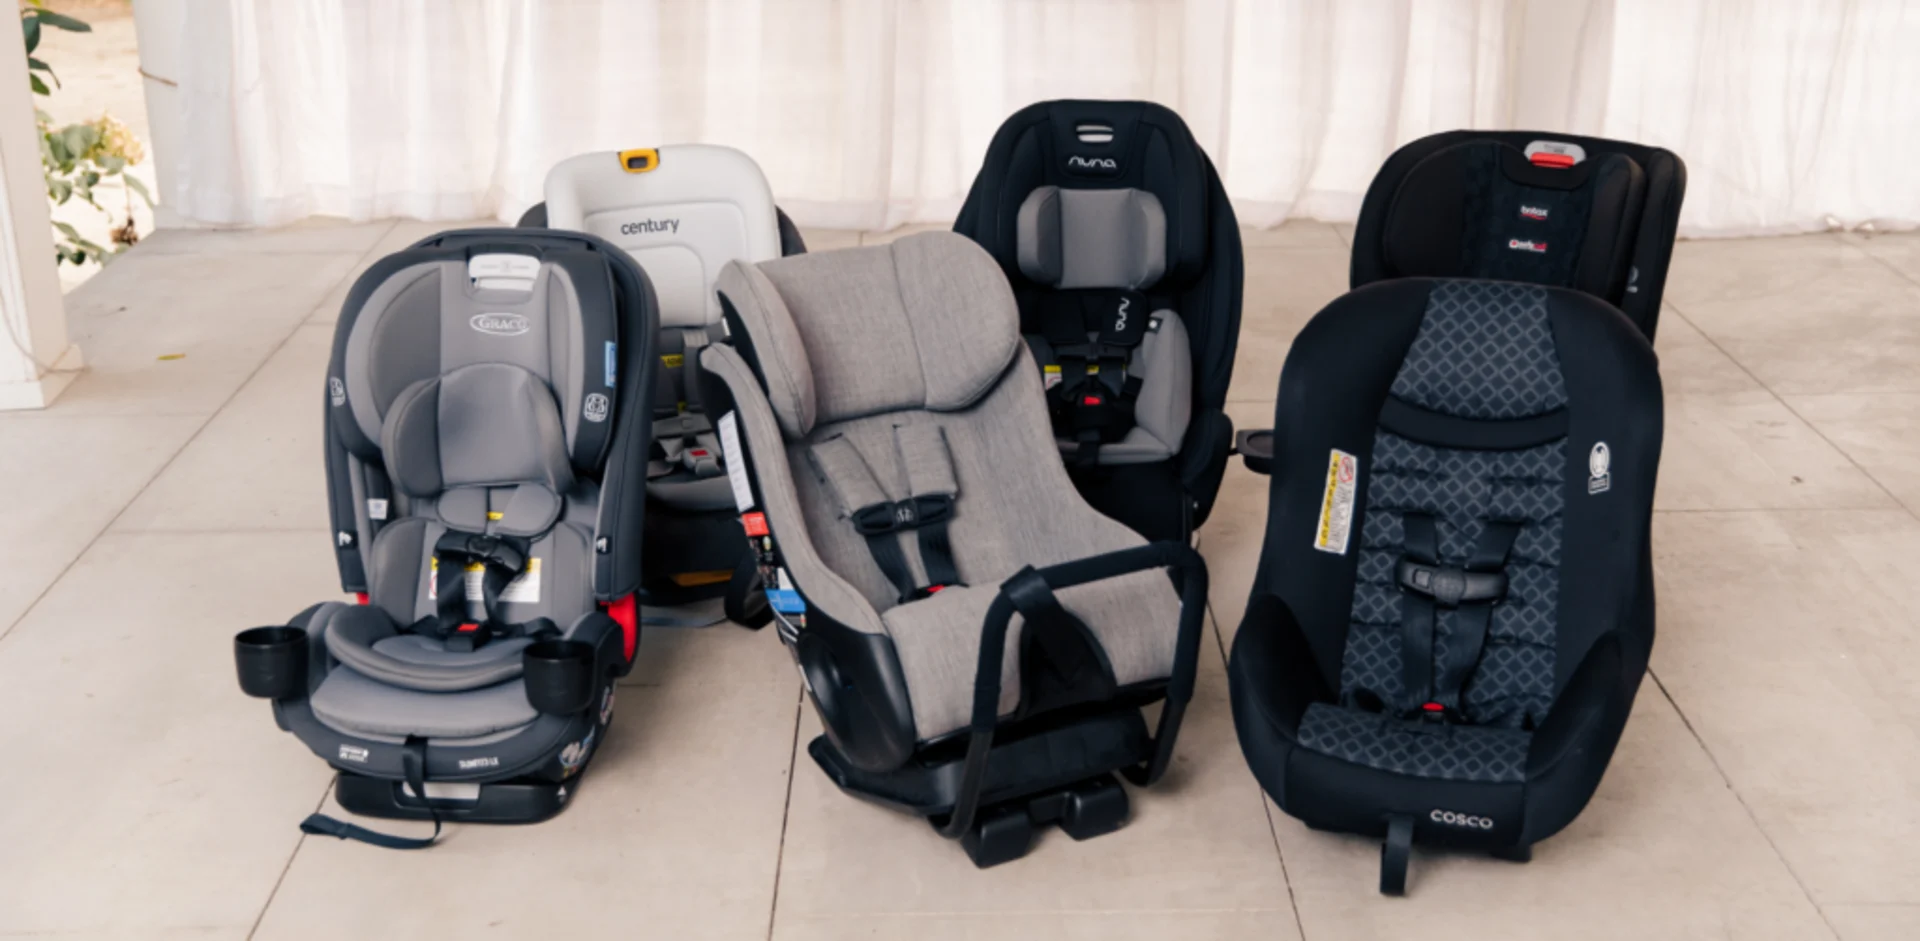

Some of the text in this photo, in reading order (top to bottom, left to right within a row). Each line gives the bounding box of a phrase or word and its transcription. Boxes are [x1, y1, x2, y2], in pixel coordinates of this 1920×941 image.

[1068, 156, 1116, 168] nuna
[620, 218, 680, 235] century
[1430, 809, 1493, 830] COSCO
